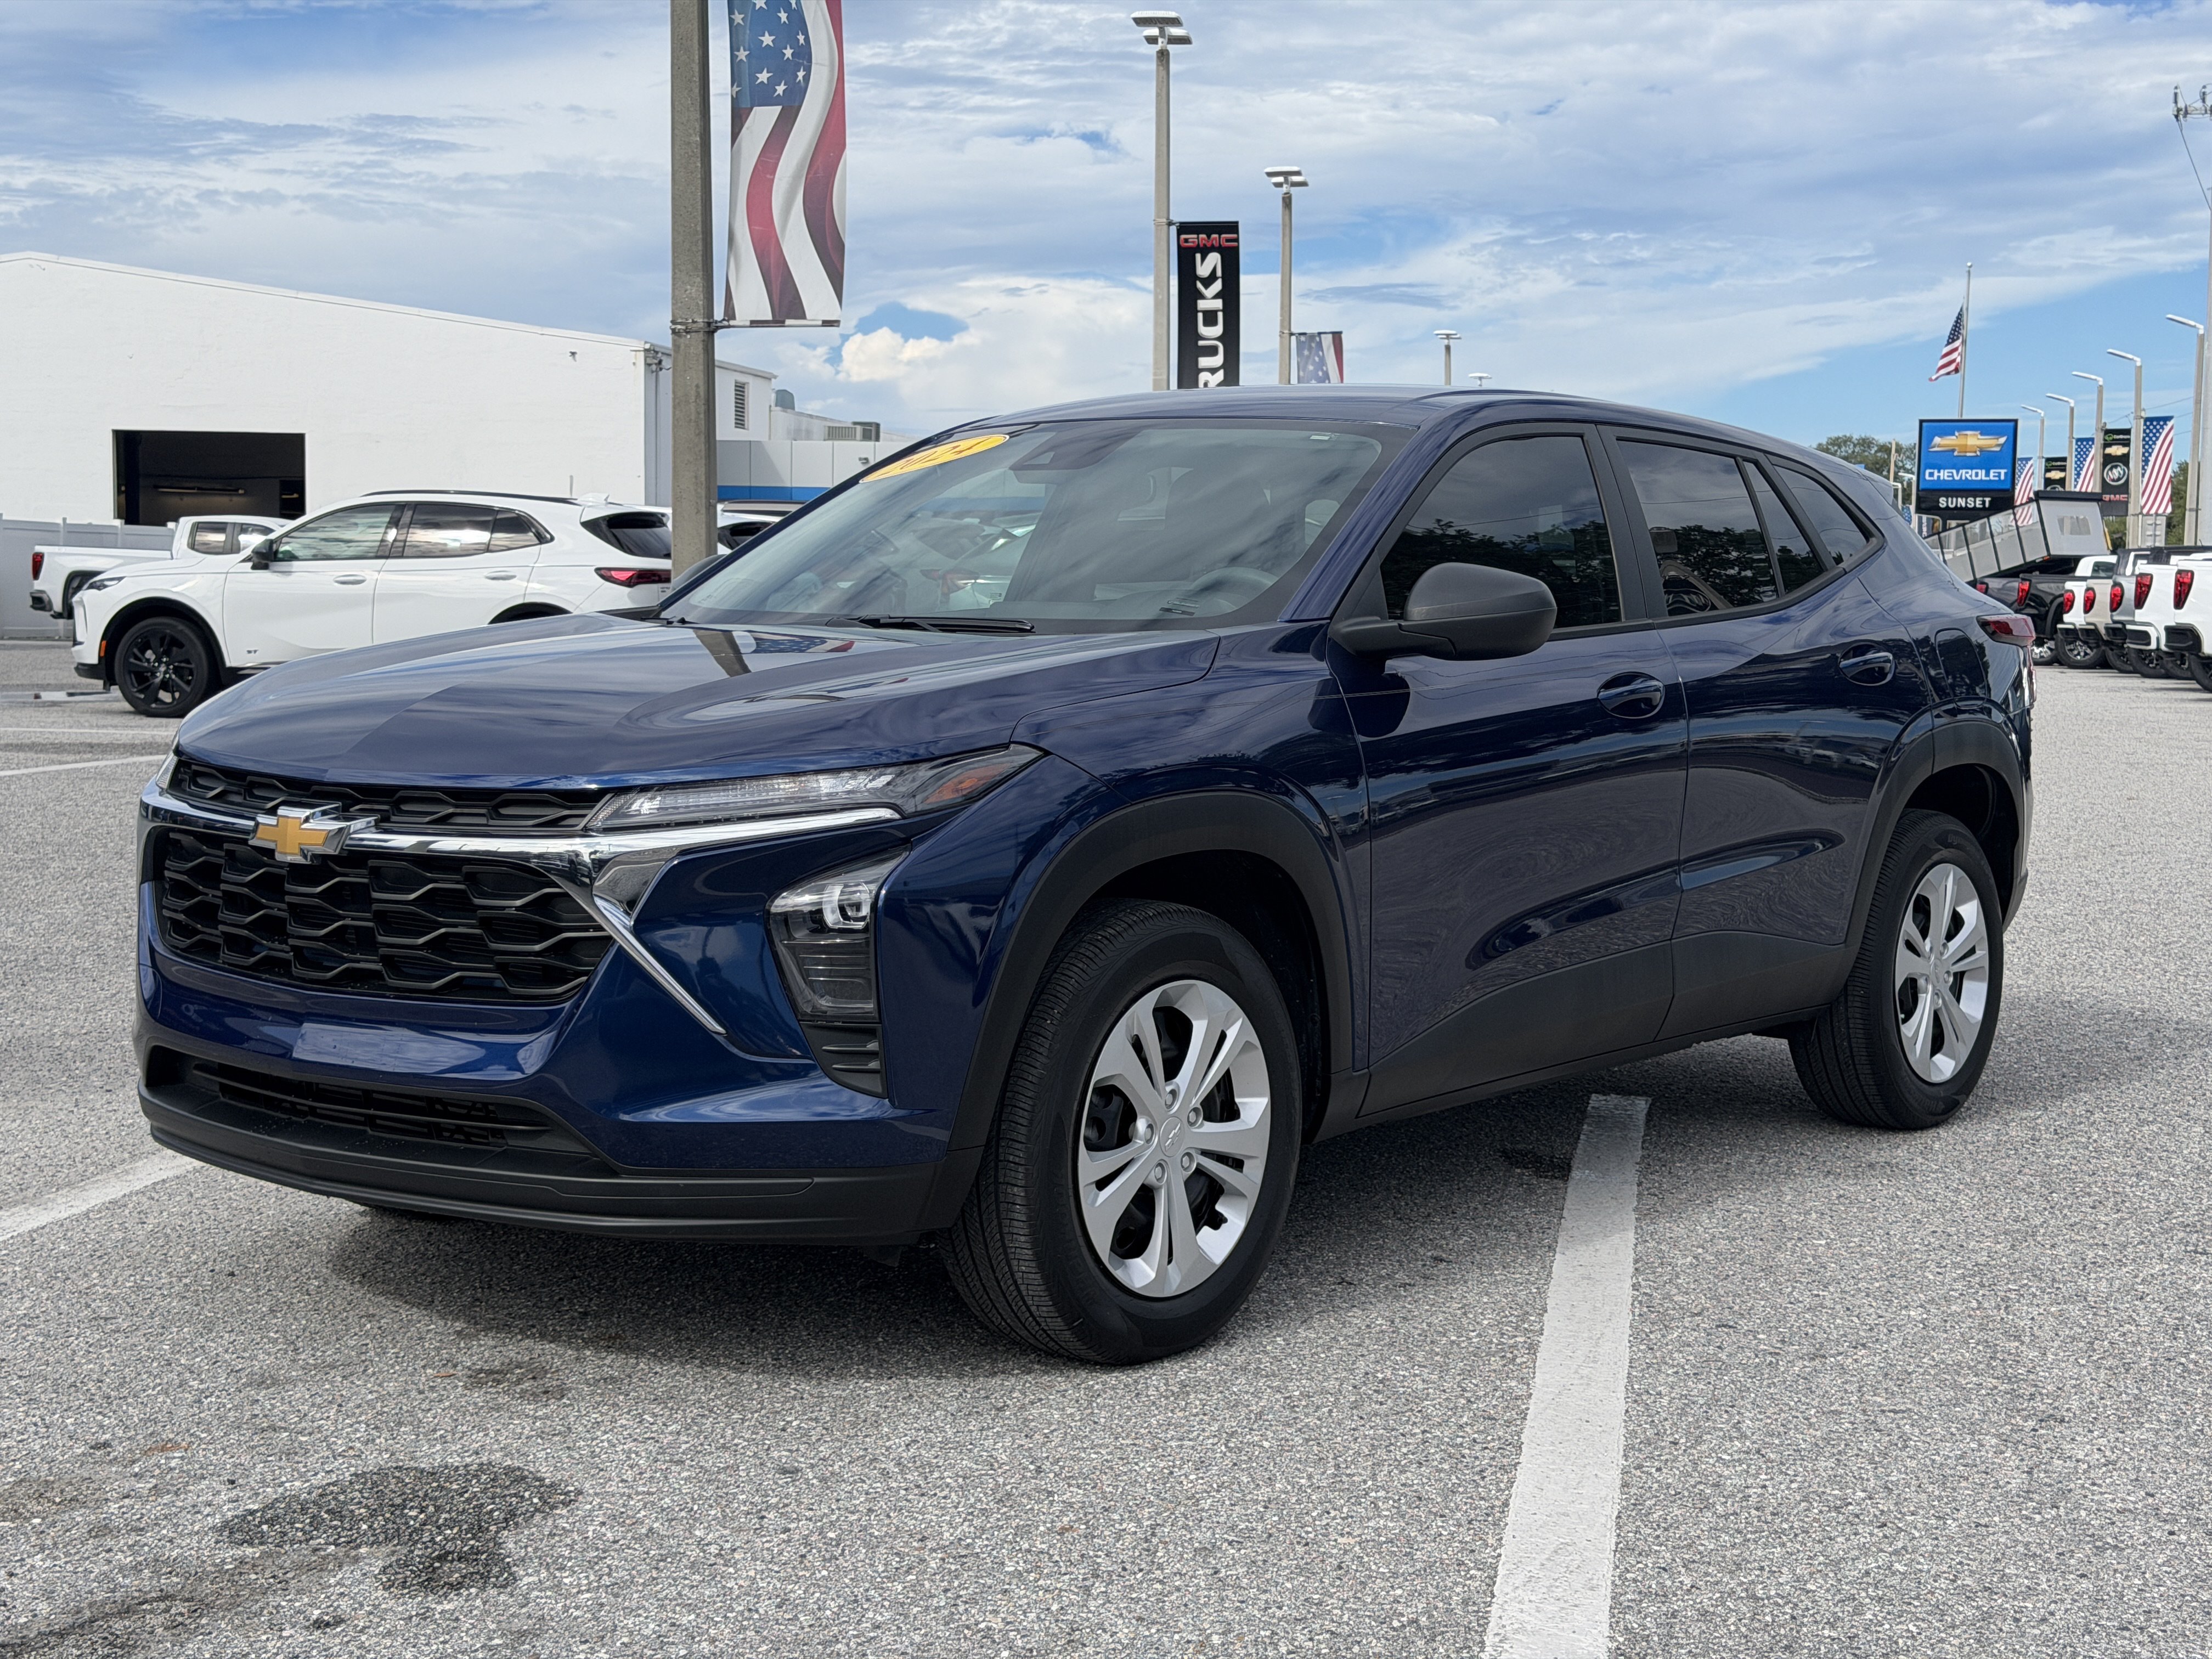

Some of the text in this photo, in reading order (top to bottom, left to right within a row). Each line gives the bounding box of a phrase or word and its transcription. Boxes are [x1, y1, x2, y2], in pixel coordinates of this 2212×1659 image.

[1180, 234, 1238, 247] GMC
[1925, 469, 2008, 481] CHEVROLET
[1938, 497, 1991, 508] SUNSET
